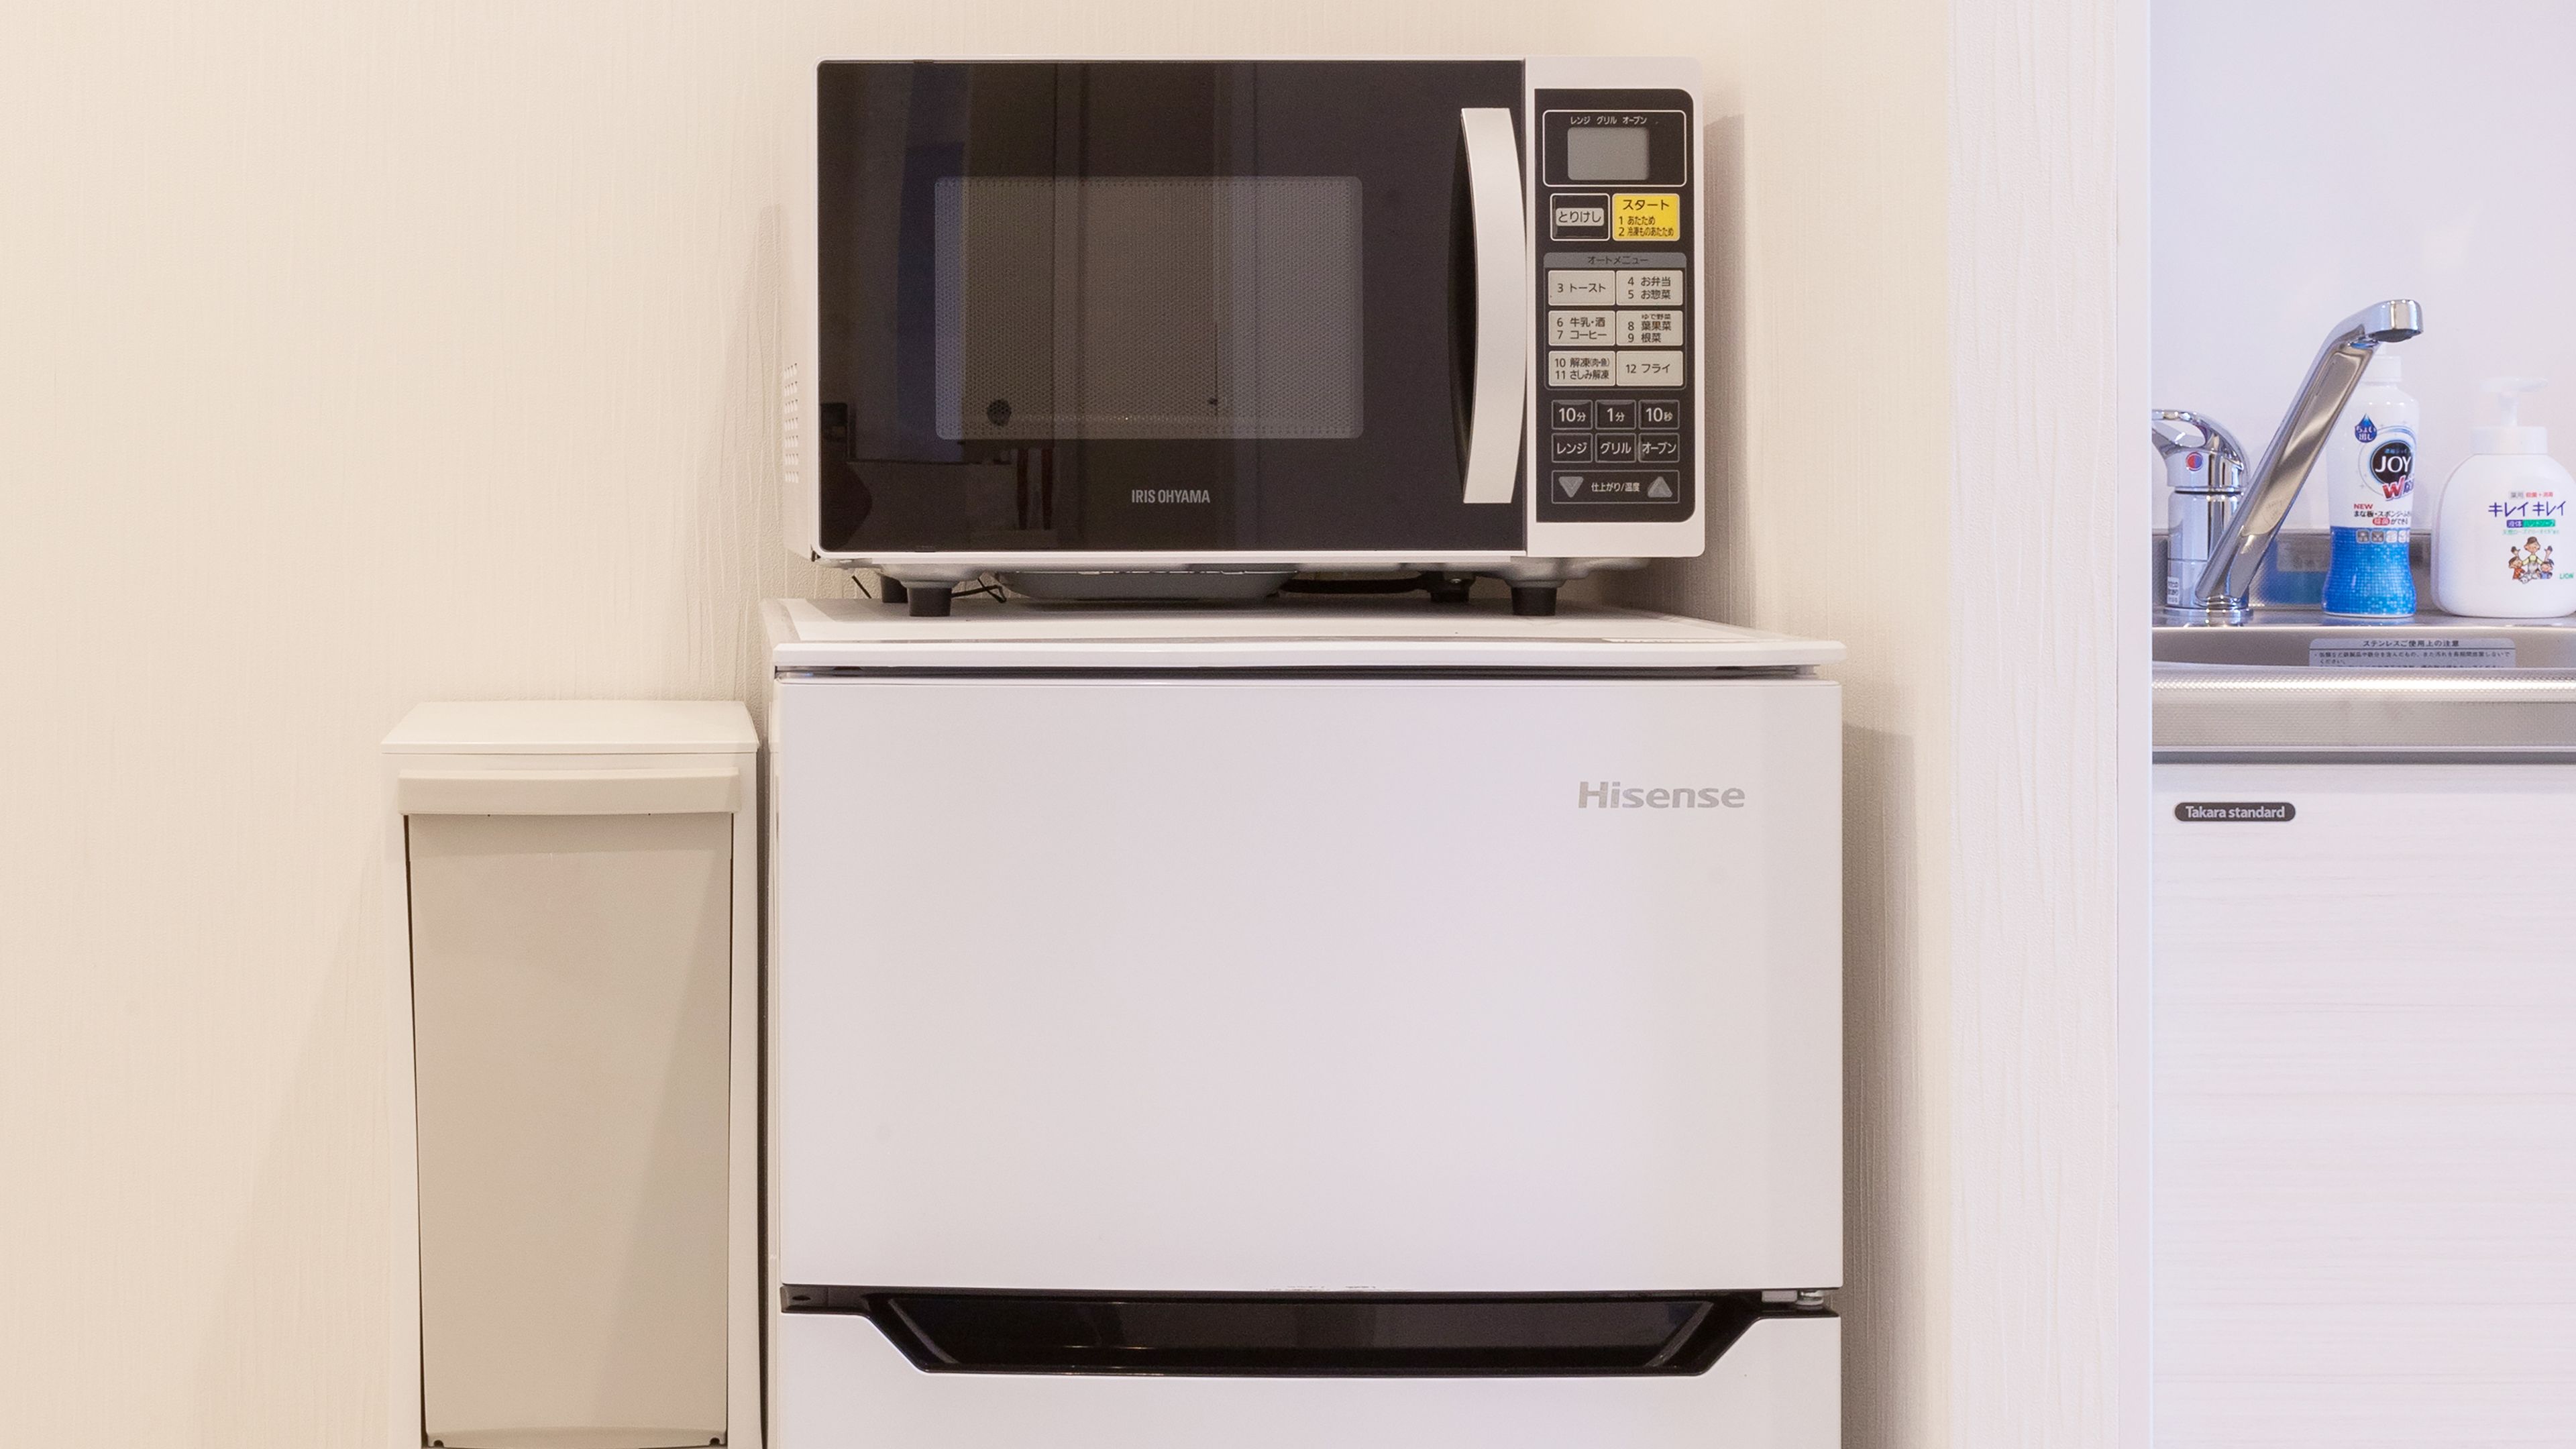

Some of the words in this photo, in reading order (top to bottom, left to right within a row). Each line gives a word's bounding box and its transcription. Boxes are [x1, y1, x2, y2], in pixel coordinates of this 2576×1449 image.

[1570, 116, 1591, 125] レンジ
[1596, 116, 1617, 125] グリル
[1622, 116, 1648, 125] オープン
[1623, 199, 1670, 211] スタート
[1558, 211, 1602, 223] とりけし
[1618, 216, 1623, 225] 1
[1627, 216, 1656, 225] あたため
[1618, 227, 1625, 237] 2
[1587, 256, 1649, 265] オートメニュー
[1627, 276, 1635, 286] 4
[1640, 276, 1671, 287] お弁当
[1557, 283, 1564, 292] 3
[1570, 282, 1607, 293] トースト
[1627, 290, 1634, 299] 5
[1640, 289, 1672, 300] お惣菜
[1556, 317, 1564, 327] 6
[1570, 317, 1606, 327] 牛乳・酒
[1627, 321, 1635, 331] 8
[1641, 321, 1672, 331] 葉果菜
[1556, 330, 1564, 340] 7
[1570, 330, 1608, 340] コーヒー
[1627, 333, 1635, 343] 9
[1641, 333, 1662, 343] 根菜
[1554, 358, 1566, 368] 10
[1625, 364, 1637, 374] 12
[1641, 364, 1671, 374] フライ
[1555, 370, 1566, 380] 11
[1570, 370, 1609, 380] さしみ解凍
[1558, 407, 1587, 422] 10分
[1606, 407, 1625, 422] 1分
[1645, 407, 1673, 422] 10秒
[1556, 442, 1588, 455] レンジ
[1600, 441, 1631, 455] グリル
[1642, 441, 1677, 455] オープン
[2375, 456, 2412, 473] JOY
[1591, 482, 1641, 492] 仕上がり/温度
[1131, 489, 1156, 503] IRIS
[1157, 489, 1211, 503] OHYAMA
[1578, 781, 1746, 809] Hisense
[2185, 806, 2226, 818] Takara
[2228, 806, 2286, 818] standard
